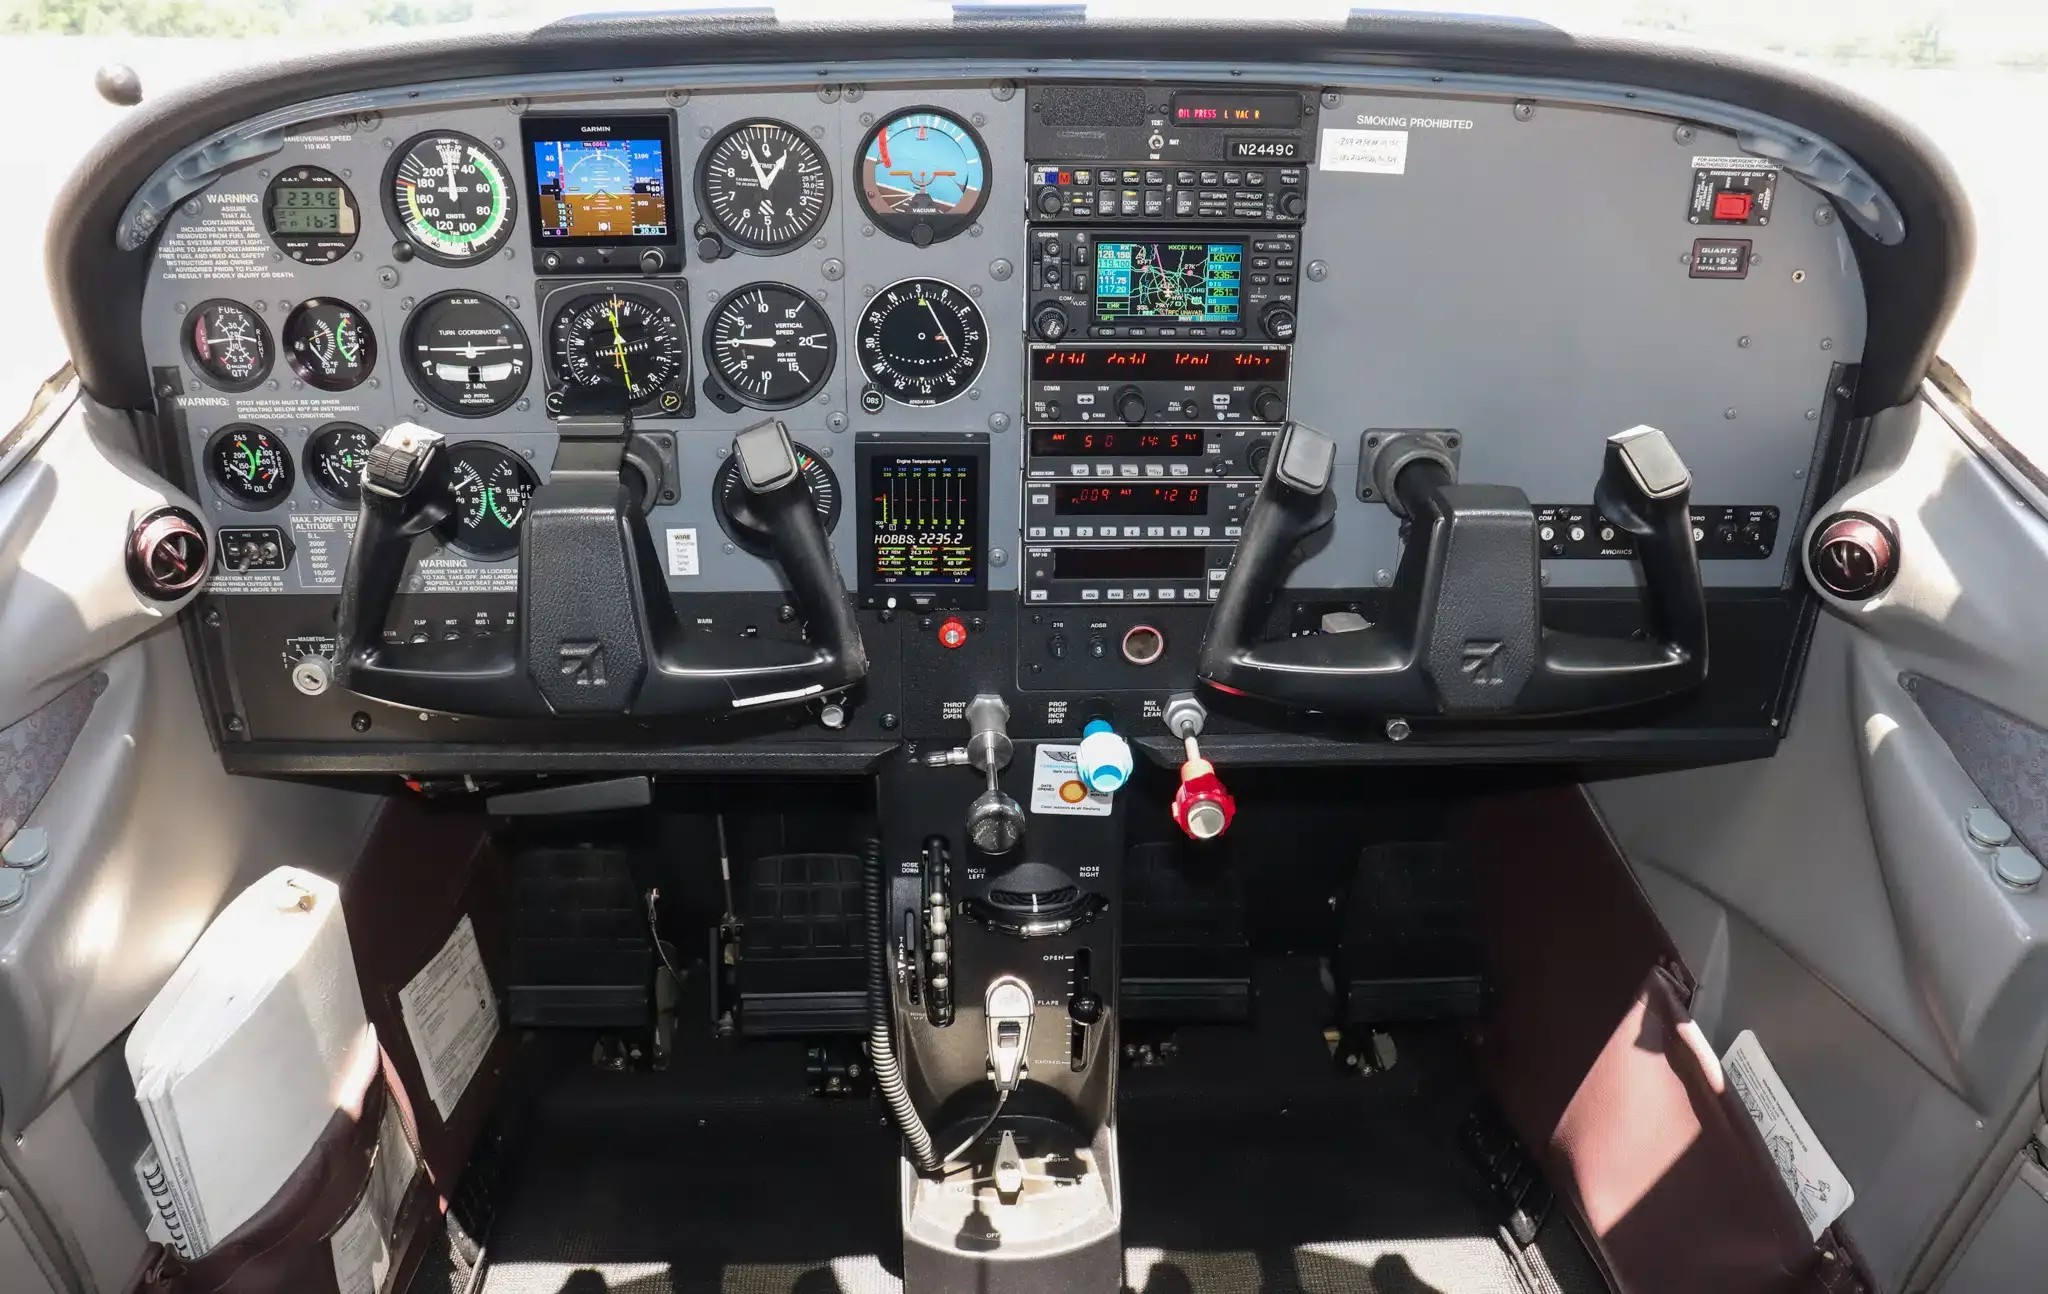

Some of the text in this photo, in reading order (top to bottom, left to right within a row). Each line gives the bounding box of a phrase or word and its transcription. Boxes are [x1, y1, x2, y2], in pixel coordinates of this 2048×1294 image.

[1179, 110, 1216, 118] OIL PRESS
[1225, 110, 1259, 119] L VAC R
[1357, 115, 1473, 129] SMOKING PROHIBITED
[1238, 144, 1294, 155] N2449C
[741, 150, 749, 159] 9
[461, 165, 475, 174] 40
[798, 163, 805, 172] 2
[423, 168, 443, 177] 200
[728, 168, 735, 177] 8
[417, 179, 435, 188] 180
[476, 184, 489, 193] 60
[207, 194, 258, 203] WARNING
[416, 194, 433, 204] 160
[730, 192, 735, 201] 7
[800, 196, 807, 205] 3
[422, 208, 439, 217] 140
[476, 207, 490, 215] 80
[743, 209, 750, 218] 6
[786, 208, 793, 217] 4
[765, 216, 771, 225] 5
[436, 221, 453, 230] 120
[460, 223, 476, 232] 100
[888, 293, 897, 303] N
[758, 303, 768, 314] 10
[786, 309, 796, 319] 15
[738, 317, 744, 326] 5
[799, 337, 813, 347] 20
[741, 360, 747, 370] 5
[789, 362, 799, 372] 15
[232, 369, 249, 377] QTY
[514, 366, 521, 374] R
[762, 371, 771, 381] 10
[178, 398, 229, 406] WARNING:
[866, 397, 879, 405] OBS
[875, 533, 962, 544] HOBBS: 2235.2
